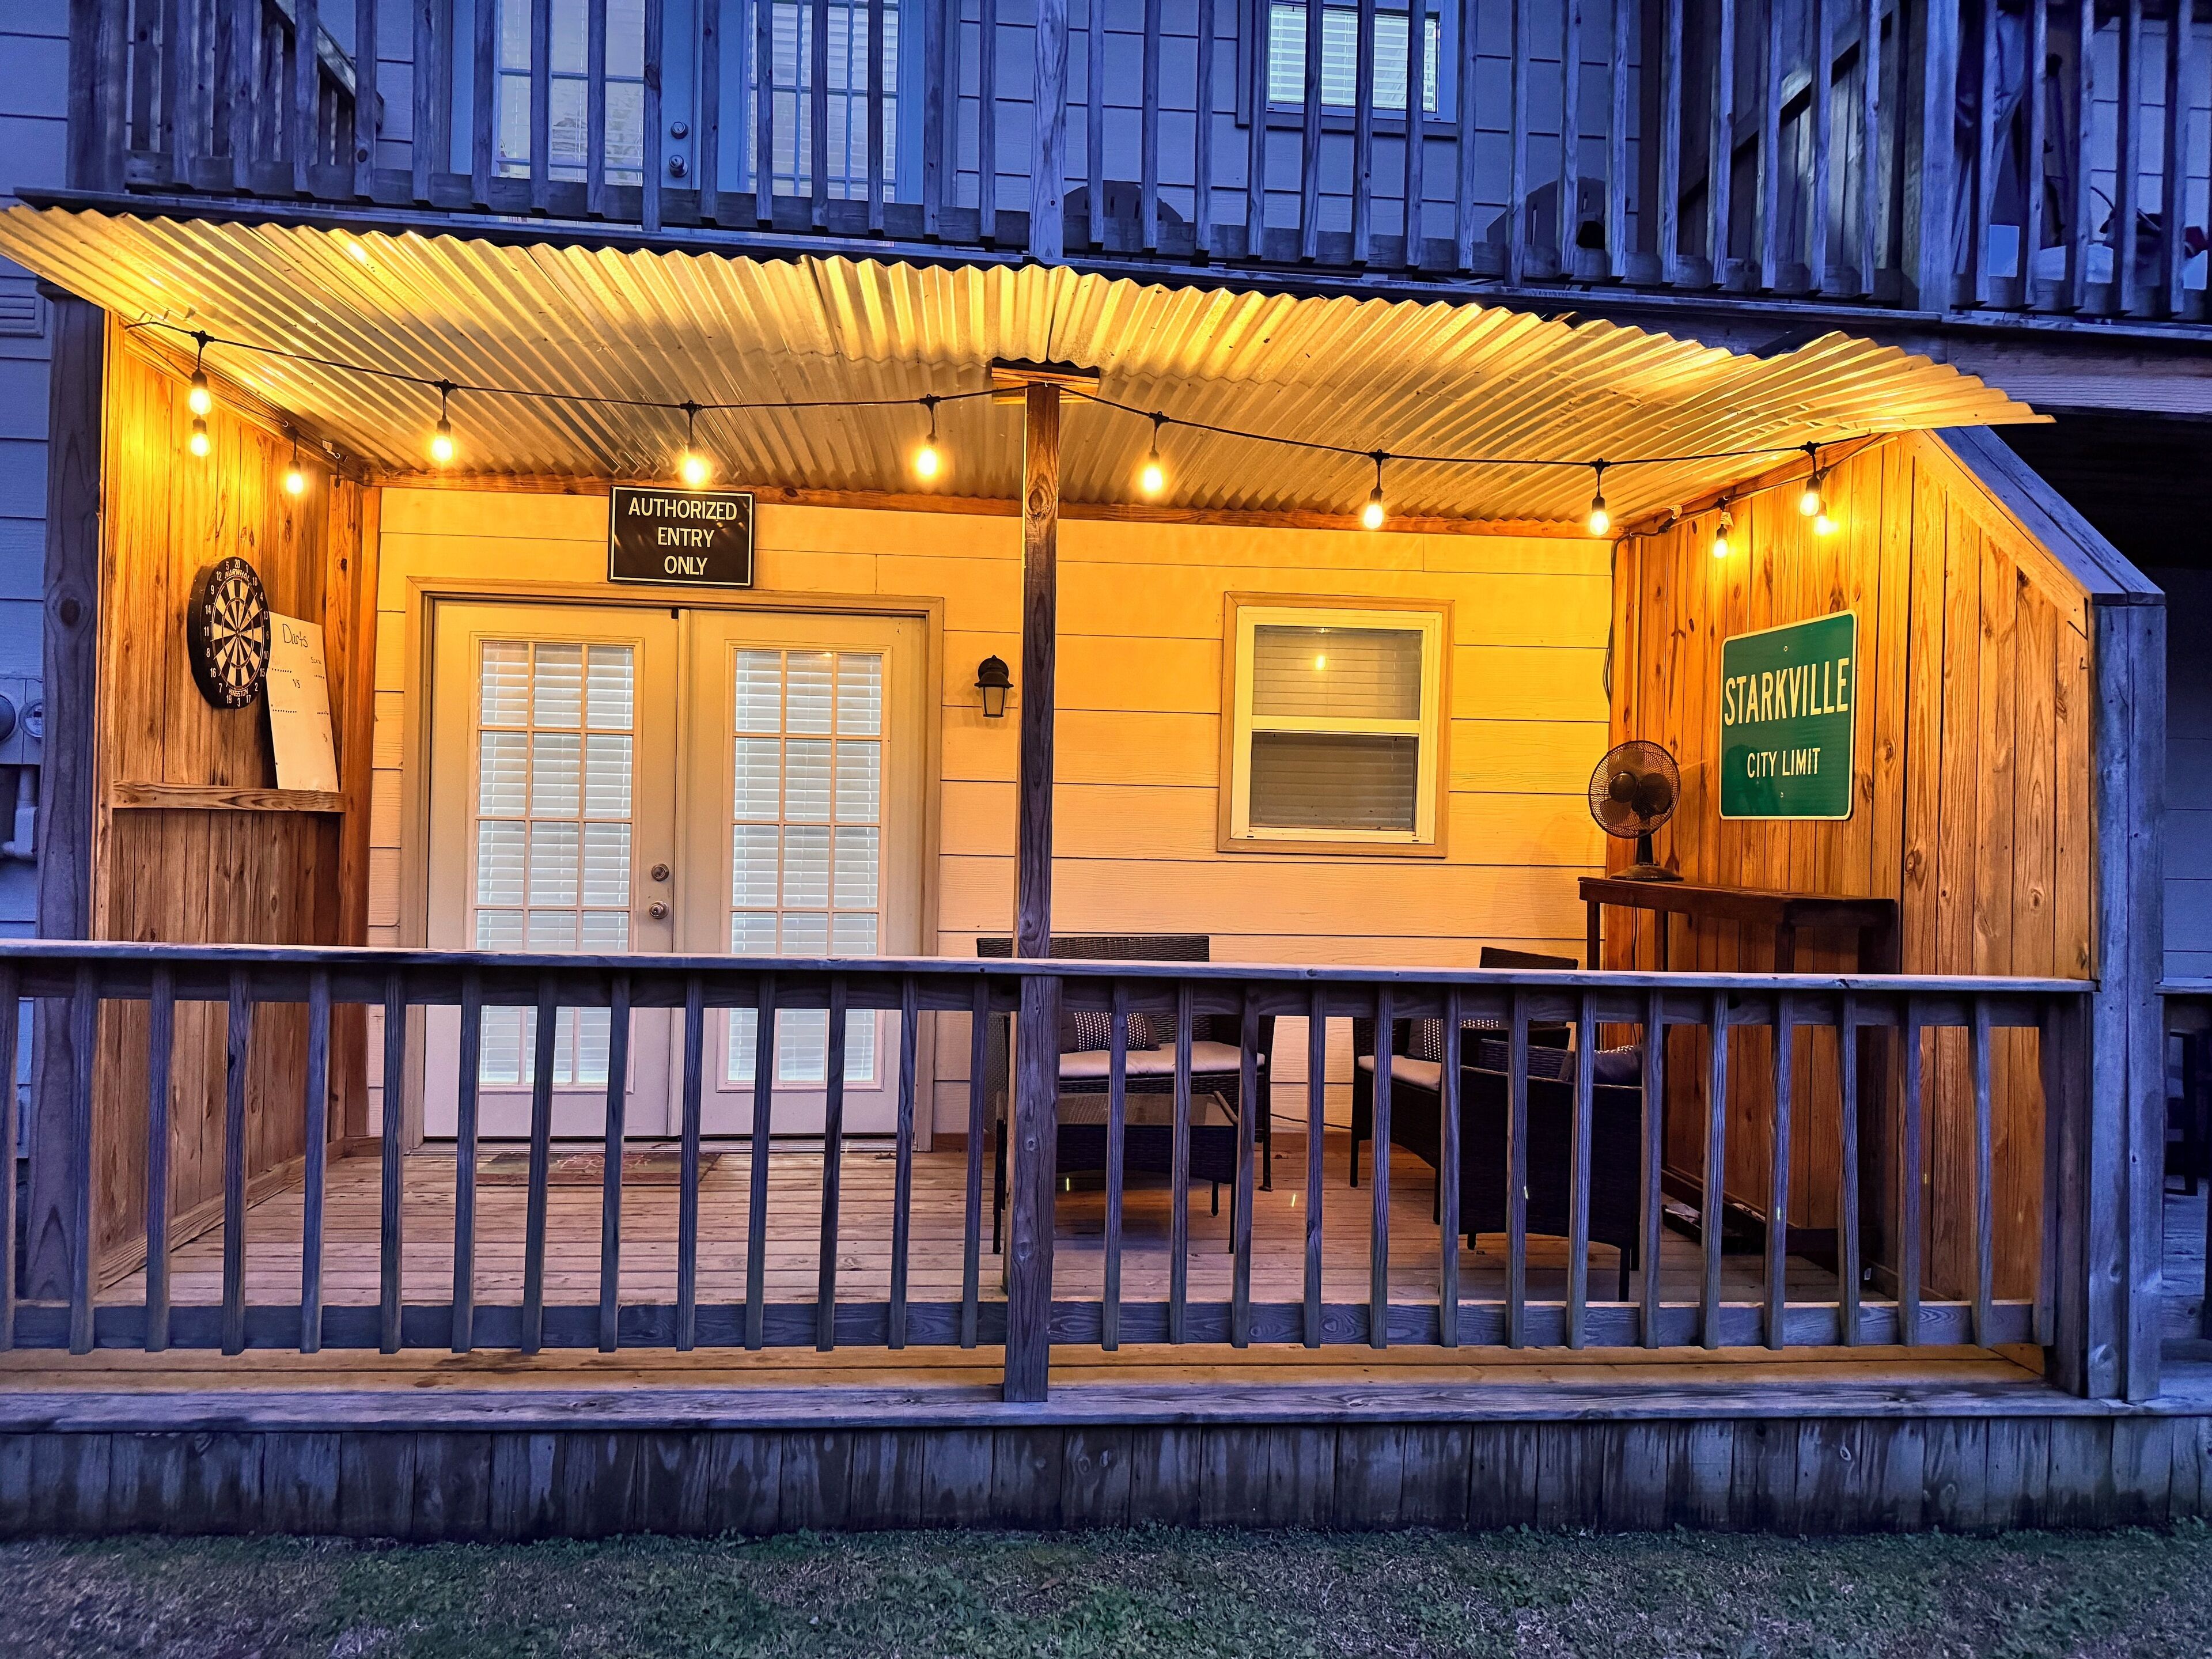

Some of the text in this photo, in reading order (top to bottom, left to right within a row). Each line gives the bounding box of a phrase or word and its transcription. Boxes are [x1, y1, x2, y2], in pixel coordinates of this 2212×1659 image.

[628, 497, 737, 520] AUTHORIZED
[657, 527, 715, 548] ENTRY
[225, 560, 229, 570] 5
[234, 559, 241, 569] 20
[245, 564, 248, 573] 1
[664, 555, 708, 575] ONLY
[216, 570, 222, 581] 12
[225, 568, 250, 582] NARWHAL
[252, 577, 258, 586] 18
[210, 584, 215, 595] 9
[260, 592, 263, 601] 4
[204, 604, 211, 615] 14
[263, 611, 268, 620] 13
[203, 626, 209, 637] 11
[266, 631, 270, 640] 6
[282, 623, 309, 647] Darts
[206, 647, 210, 658] 8
[264, 650, 269, 660] 10
[210, 667, 217, 678] 16
[260, 668, 265, 677] 15
[218, 683, 223, 693] 7
[255, 682, 259, 692] 2
[1724, 657, 1850, 726] STARKVILLE
[226, 694, 232, 704] 19
[237, 697, 241, 707] 3
[246, 694, 251, 703] 17
[1747, 747, 1821, 778] CITY LIMIT
